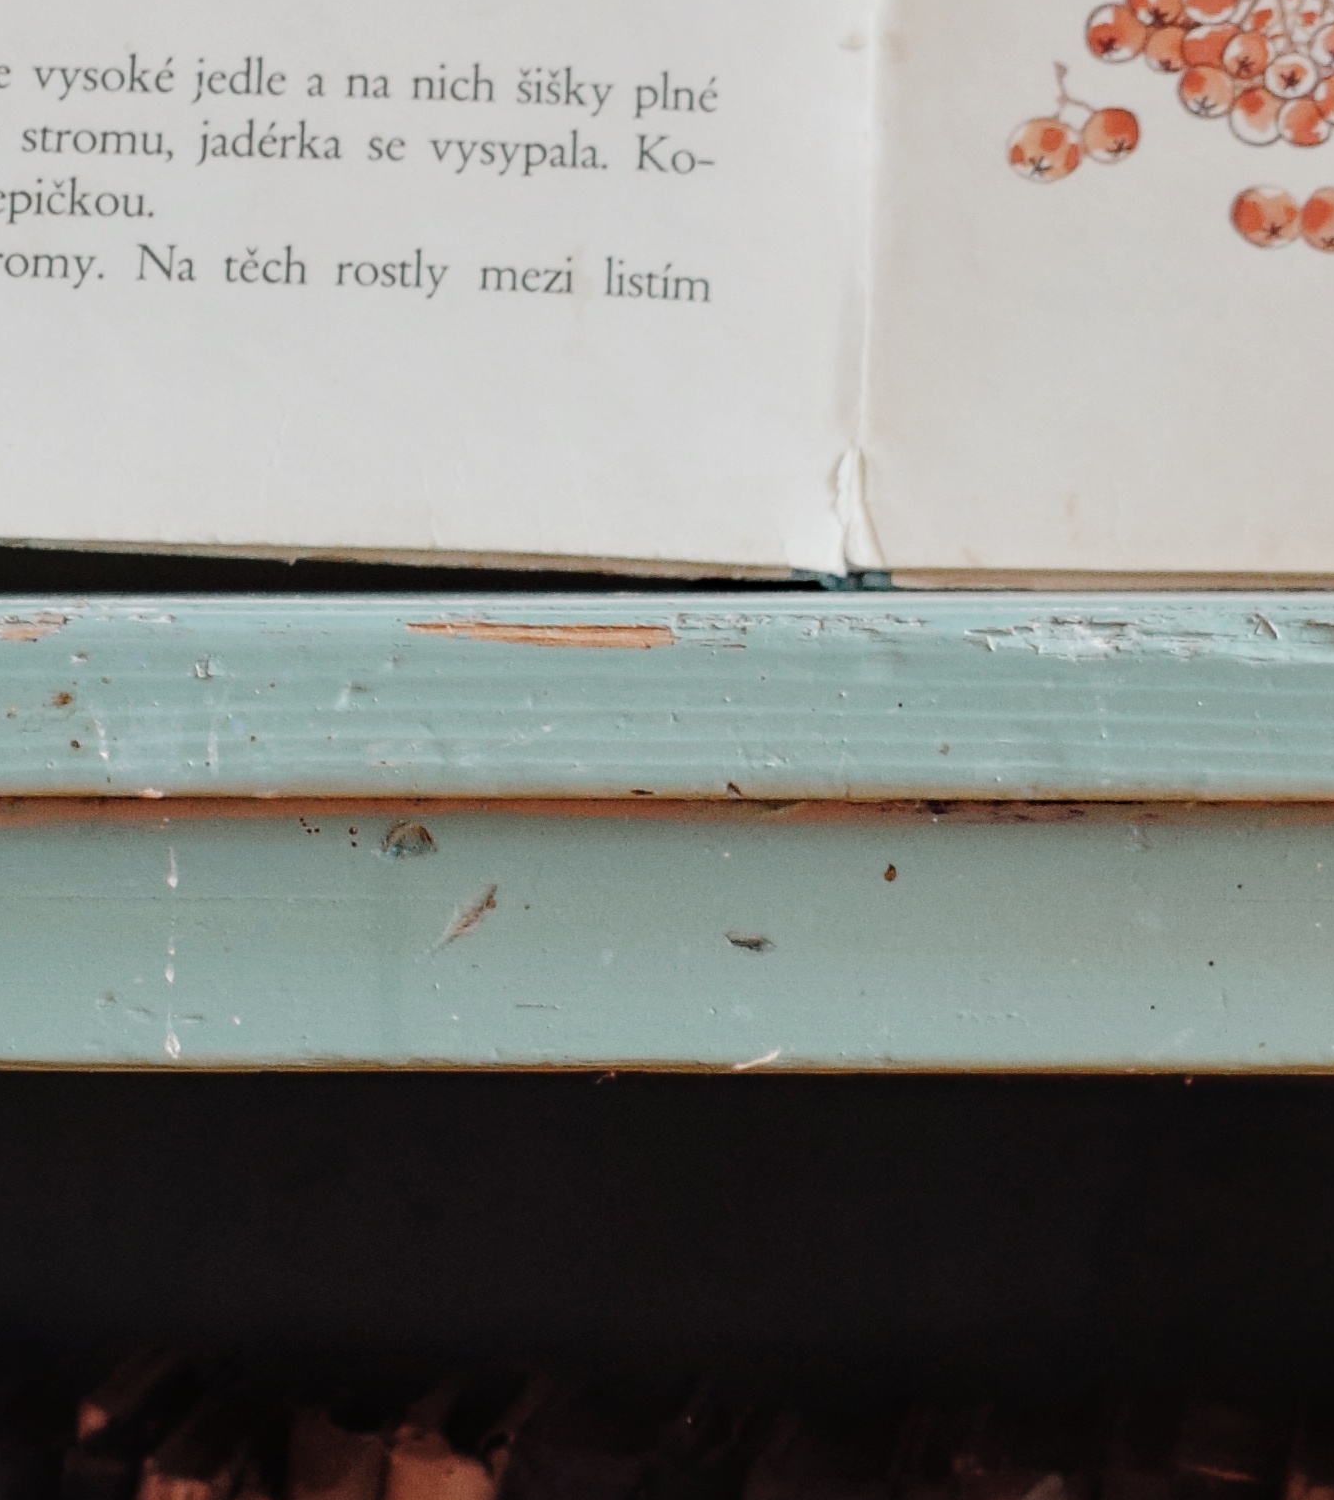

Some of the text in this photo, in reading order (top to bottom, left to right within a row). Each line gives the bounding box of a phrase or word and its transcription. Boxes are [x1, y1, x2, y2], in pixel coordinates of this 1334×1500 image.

[33, 52, 175, 102] vysoké
[191, 55, 287, 104] jedle
[305, 72, 326, 99] a
[346, 73, 391, 99] na
[412, 62, 495, 103] nich
[516, 65, 614, 117] šišky
[634, 70, 719, 119] plné
[21, 125, 174, 163] stromu,
[196, 118, 342, 166] jadérka
[367, 135, 407, 162] se
[429, 128, 608, 177] vysypala.
[636, 133, 715, 175] Ko-
[136, 243, 197, 282] Na
[224, 244, 307, 286] těch
[336, 247, 449, 300] rostly
[479, 256, 573, 295] mezi
[604, 255, 710, 303] listím
